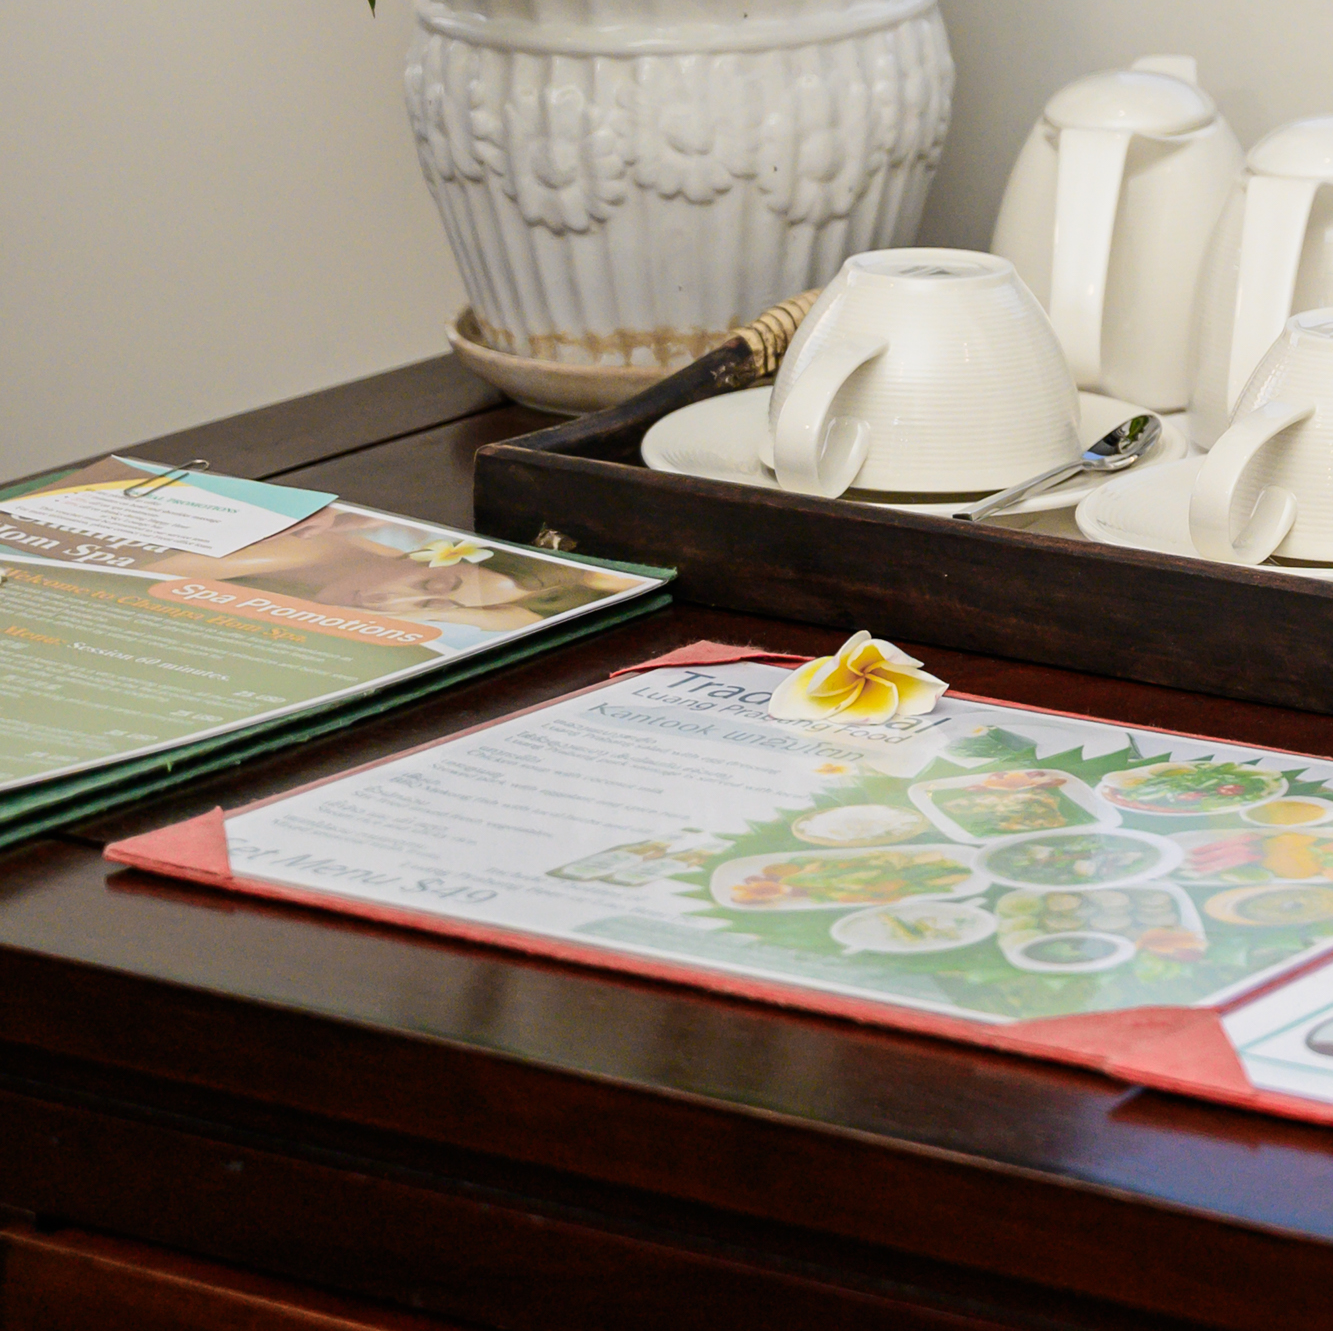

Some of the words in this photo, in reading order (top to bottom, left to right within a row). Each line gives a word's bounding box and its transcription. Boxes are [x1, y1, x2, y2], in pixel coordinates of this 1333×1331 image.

[62, 543, 136, 568] Spa
[91, 589, 116, 601] to
[171, 583, 238, 605] Spa
[234, 597, 425, 643] Promotions
[587, 702, 720, 738] Kantook
[631, 685, 720, 713] Luang
[832, 723, 914, 746] Food
[270, 852, 403, 886] Menu
[400, 876, 499, 904] $49
